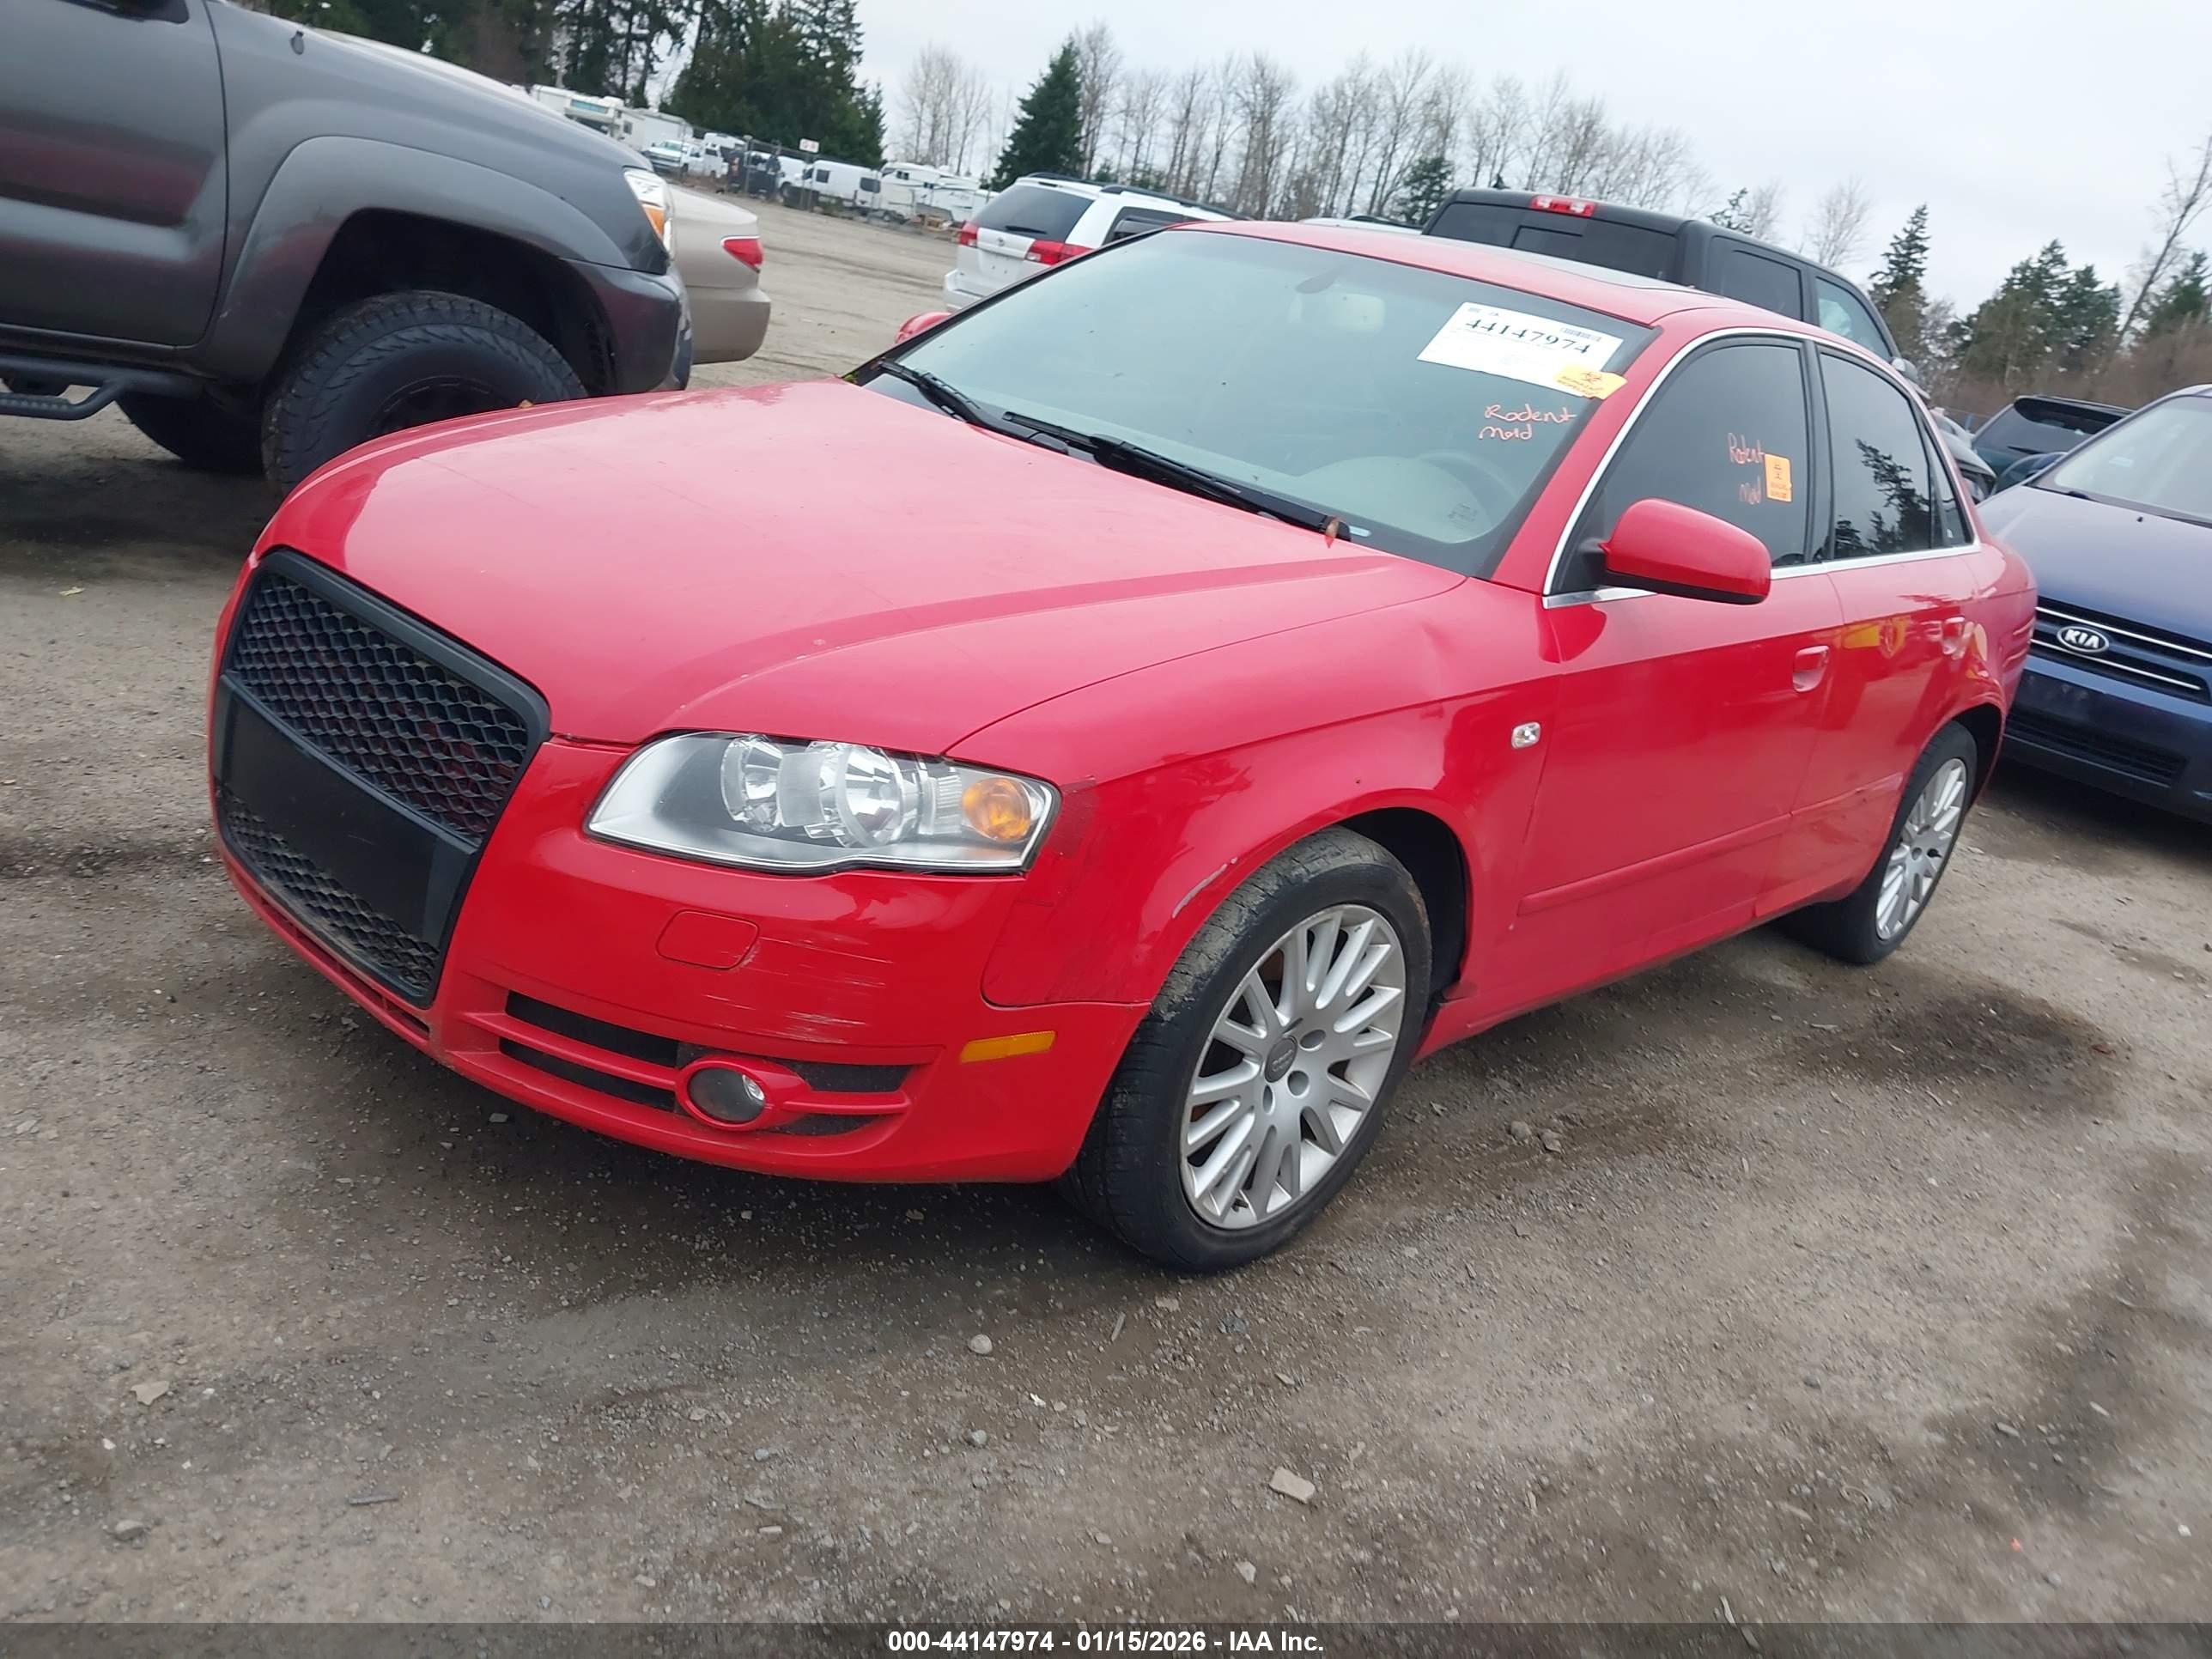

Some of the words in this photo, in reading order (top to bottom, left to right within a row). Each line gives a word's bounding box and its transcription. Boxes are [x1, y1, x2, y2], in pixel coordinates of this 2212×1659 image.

[1465, 319, 1590, 355] 44147974
[1484, 404, 1577, 423] Rodent
[2064, 629, 2100, 649] KIA
